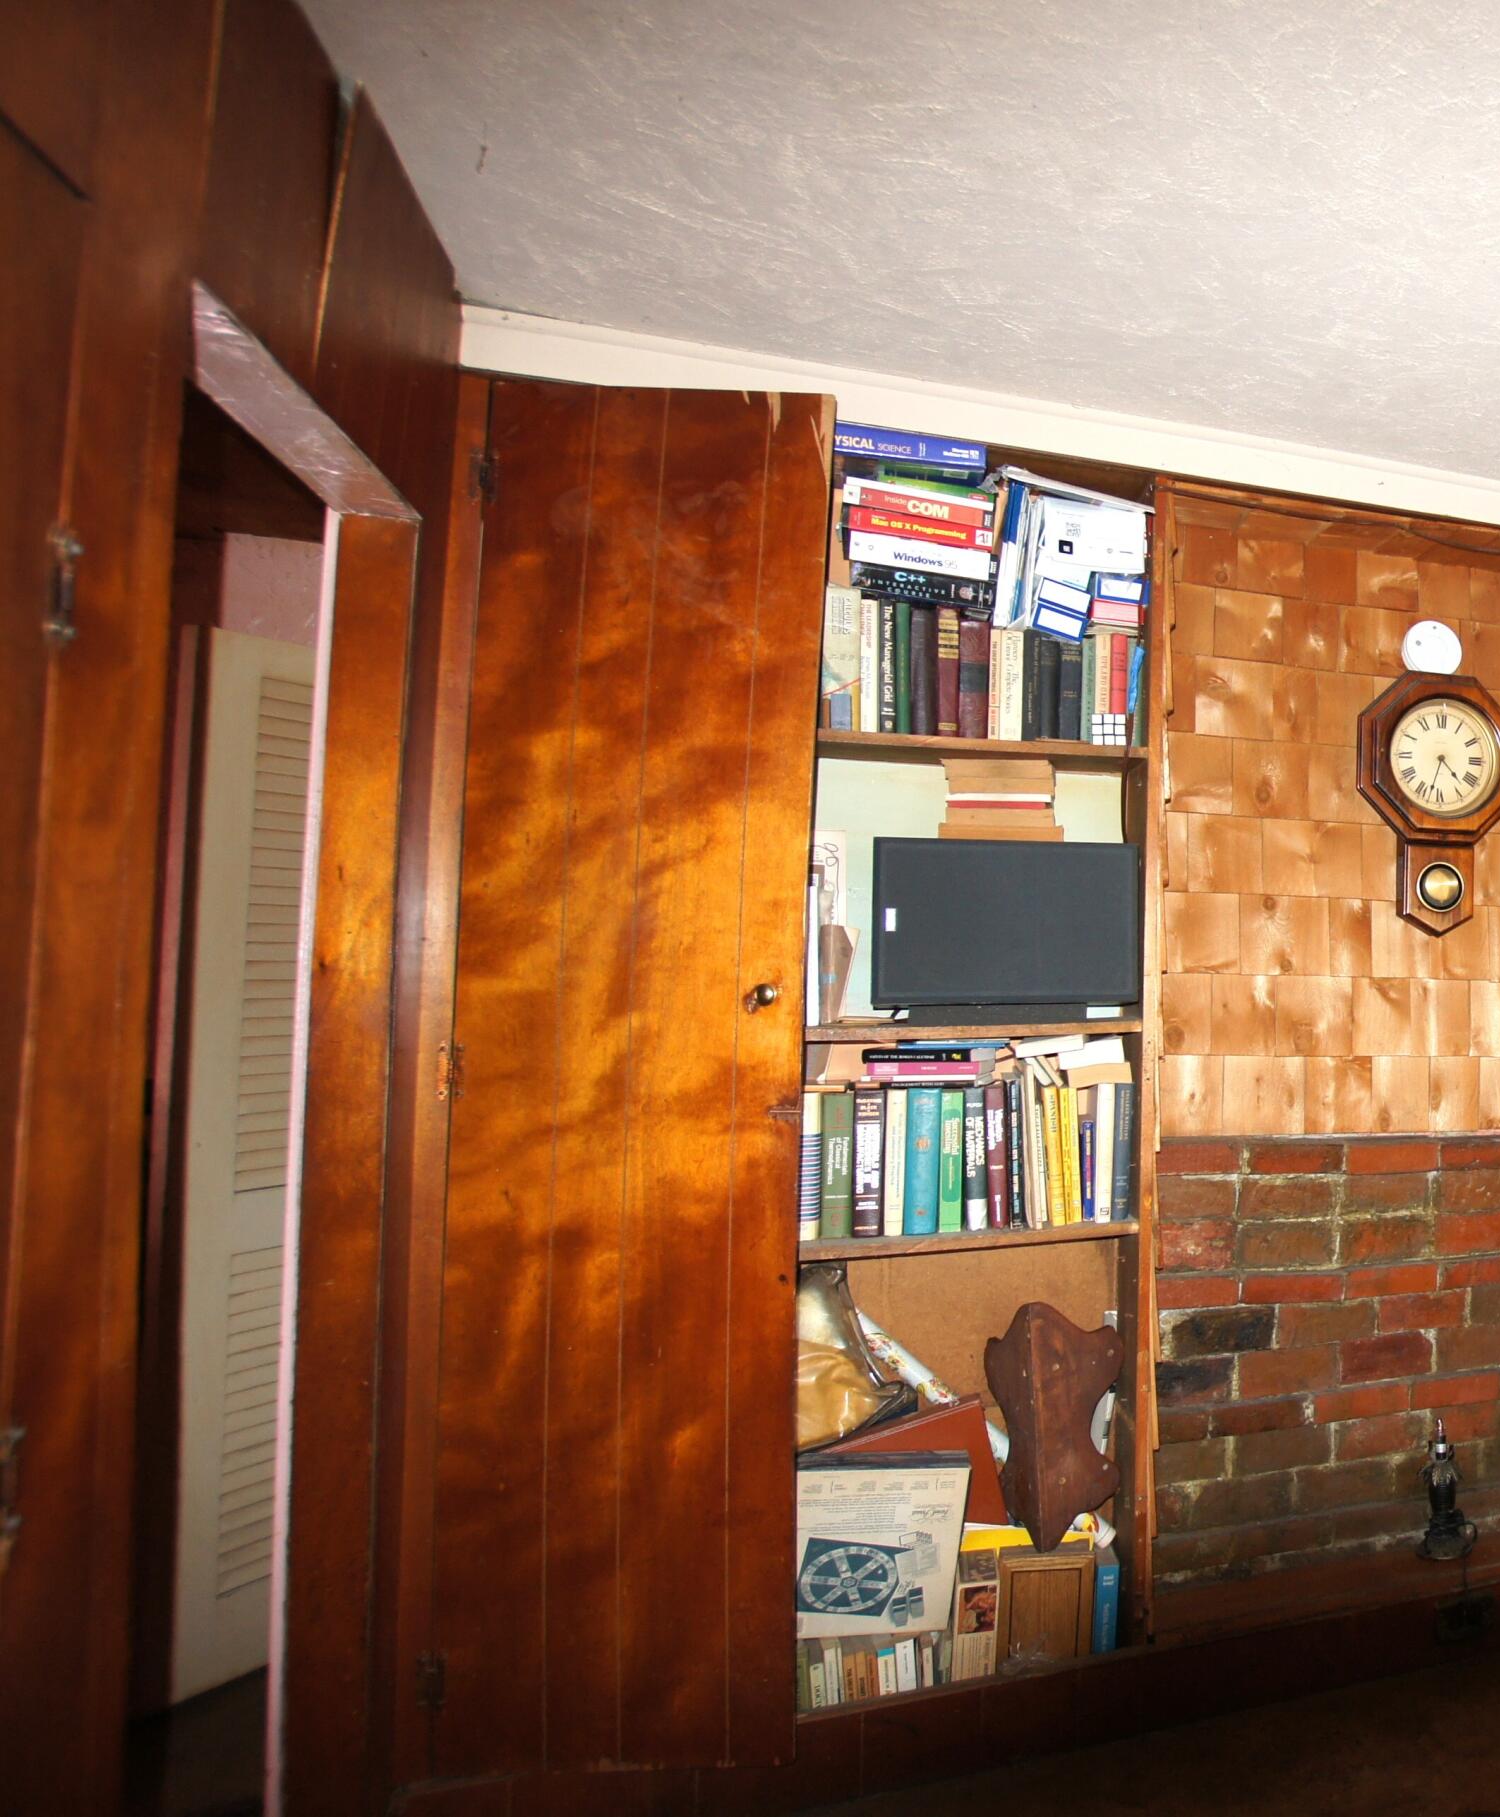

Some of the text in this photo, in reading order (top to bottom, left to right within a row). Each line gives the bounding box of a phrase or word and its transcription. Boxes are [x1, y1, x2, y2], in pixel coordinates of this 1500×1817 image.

[877, 443, 912, 454] SCIENCE
[907, 500, 949, 519] COM
[870, 517, 889, 526] Mac
[890, 520, 903, 529] OS
[904, 522, 911, 530] X
[912, 524, 967, 540] Programming
[893, 551, 943, 567] Windows
[872, 579, 946, 595] INTERACTIVE
[894, 571, 926, 584] C++
[887, 587, 931, 599] COURSE
[881, 605, 893, 702] The New Managerial Grid
[943, 1119, 952, 1154] Investing
[951, 1117, 960, 1155] Successful
[965, 1116, 975, 1178] OF MATERIALS
[974, 1115, 984, 1165] MECHANICS
[826, 1137, 835, 1185] Thermodynamics
[834, 1144, 842, 1169] Classical
